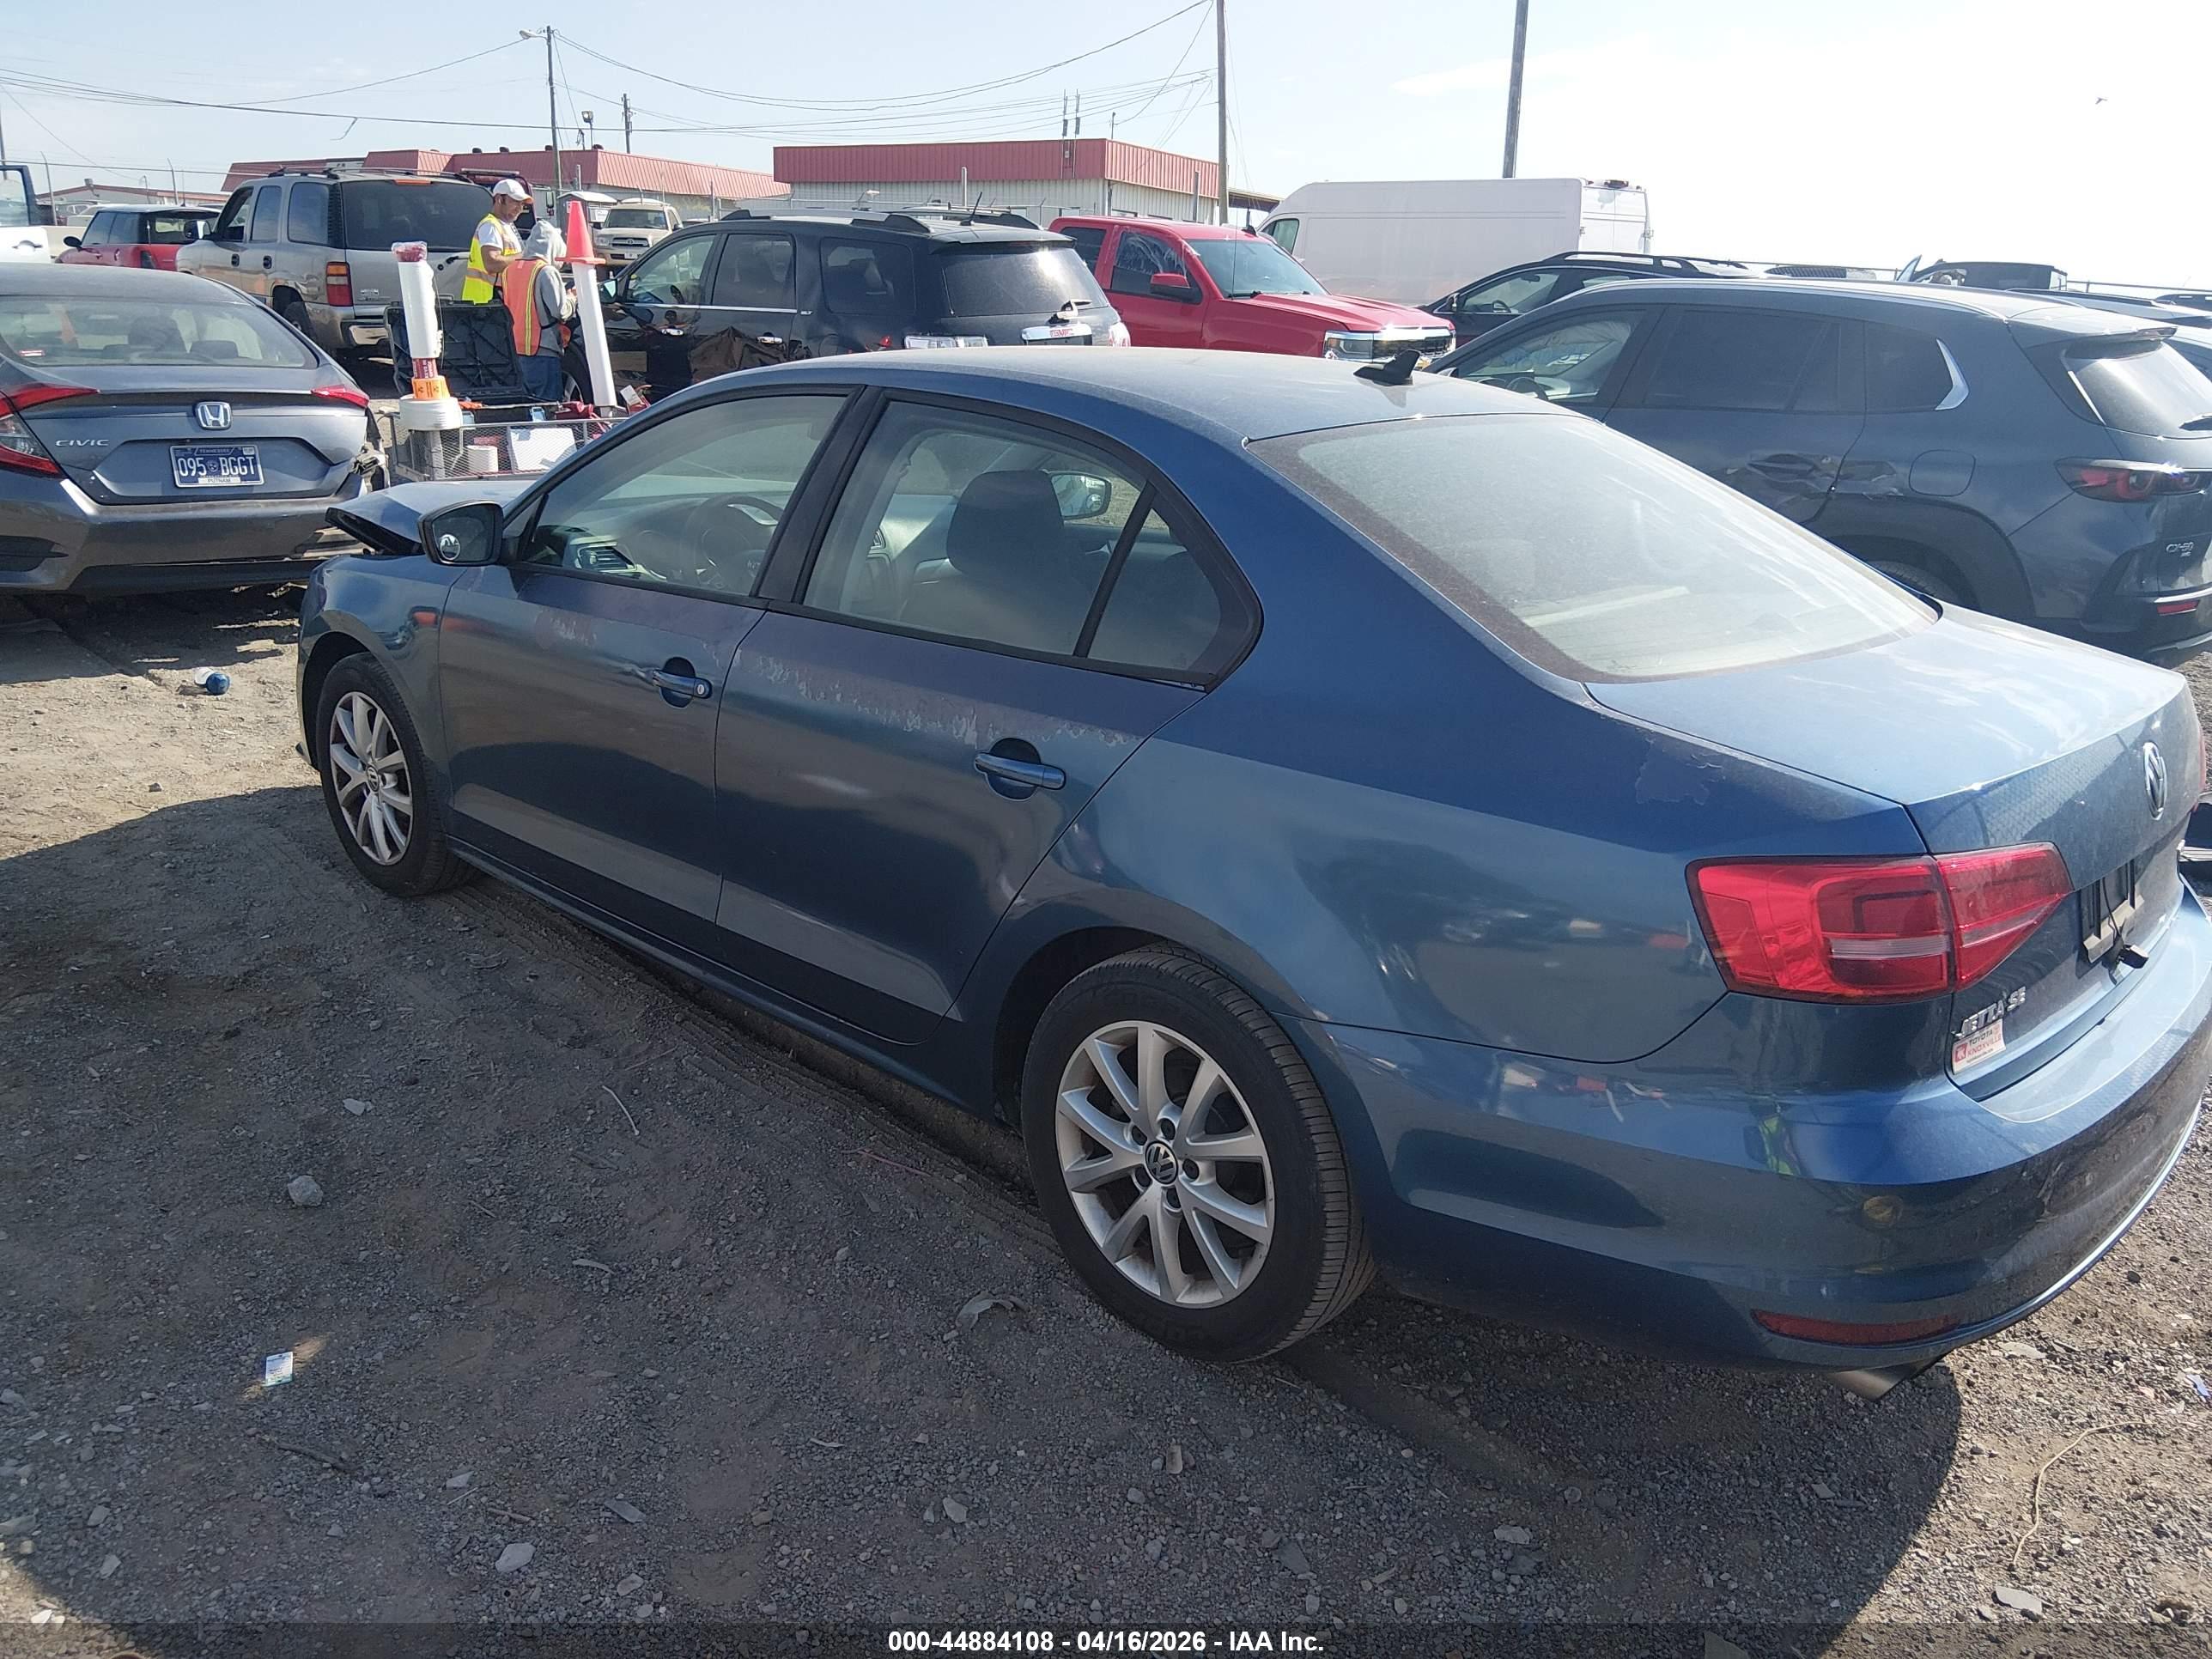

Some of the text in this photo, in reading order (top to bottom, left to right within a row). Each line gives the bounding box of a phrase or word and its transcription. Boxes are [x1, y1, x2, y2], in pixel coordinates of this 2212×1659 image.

[177, 456, 255, 477] 095 BGGT
[1951, 986, 2027, 1039] JETTA SE
[1967, 1033, 2002, 1057] KNOXVILLE
[1969, 1029, 1993, 1045] TOYOTA
